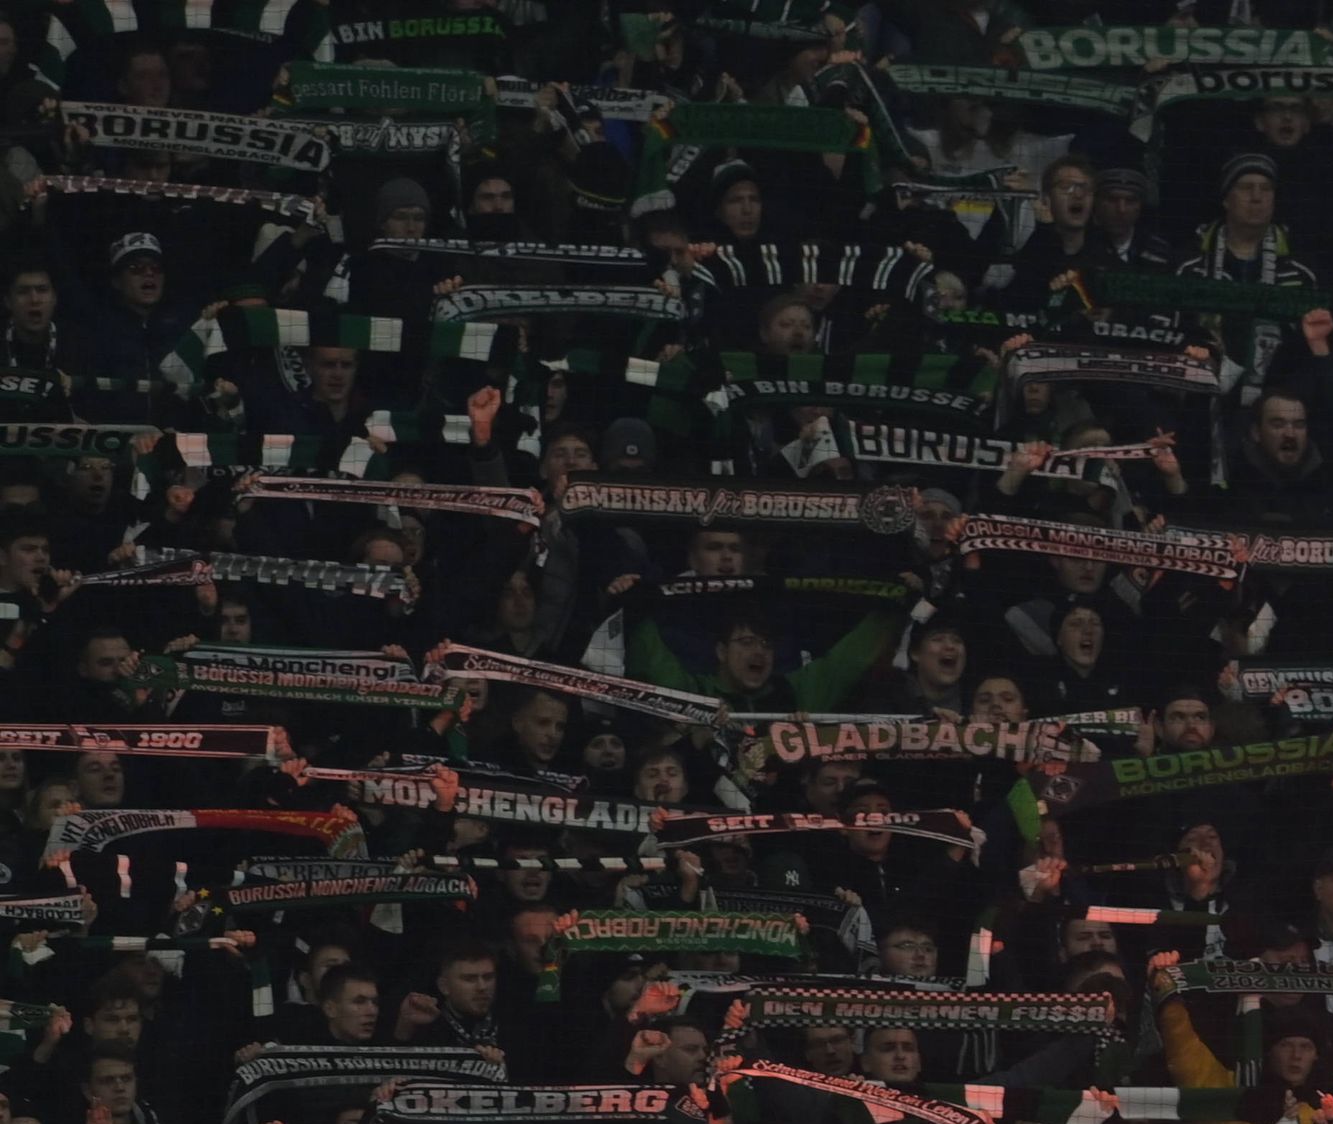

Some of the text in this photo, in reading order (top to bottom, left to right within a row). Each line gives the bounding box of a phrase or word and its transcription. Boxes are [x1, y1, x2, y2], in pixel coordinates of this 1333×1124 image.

[1025, 28, 1313, 67] BORUSSIA
[562, 481, 706, 514] GEMEINSAM
[743, 490, 860, 518] BORUSSIA
[137, 731, 203, 750] 1900
[772, 721, 1029, 762] GLADBACH
[228, 885, 305, 906] BORUSSIA
[764, 1002, 823, 1017] DEN
[836, 1002, 999, 1021] MODERNEN
